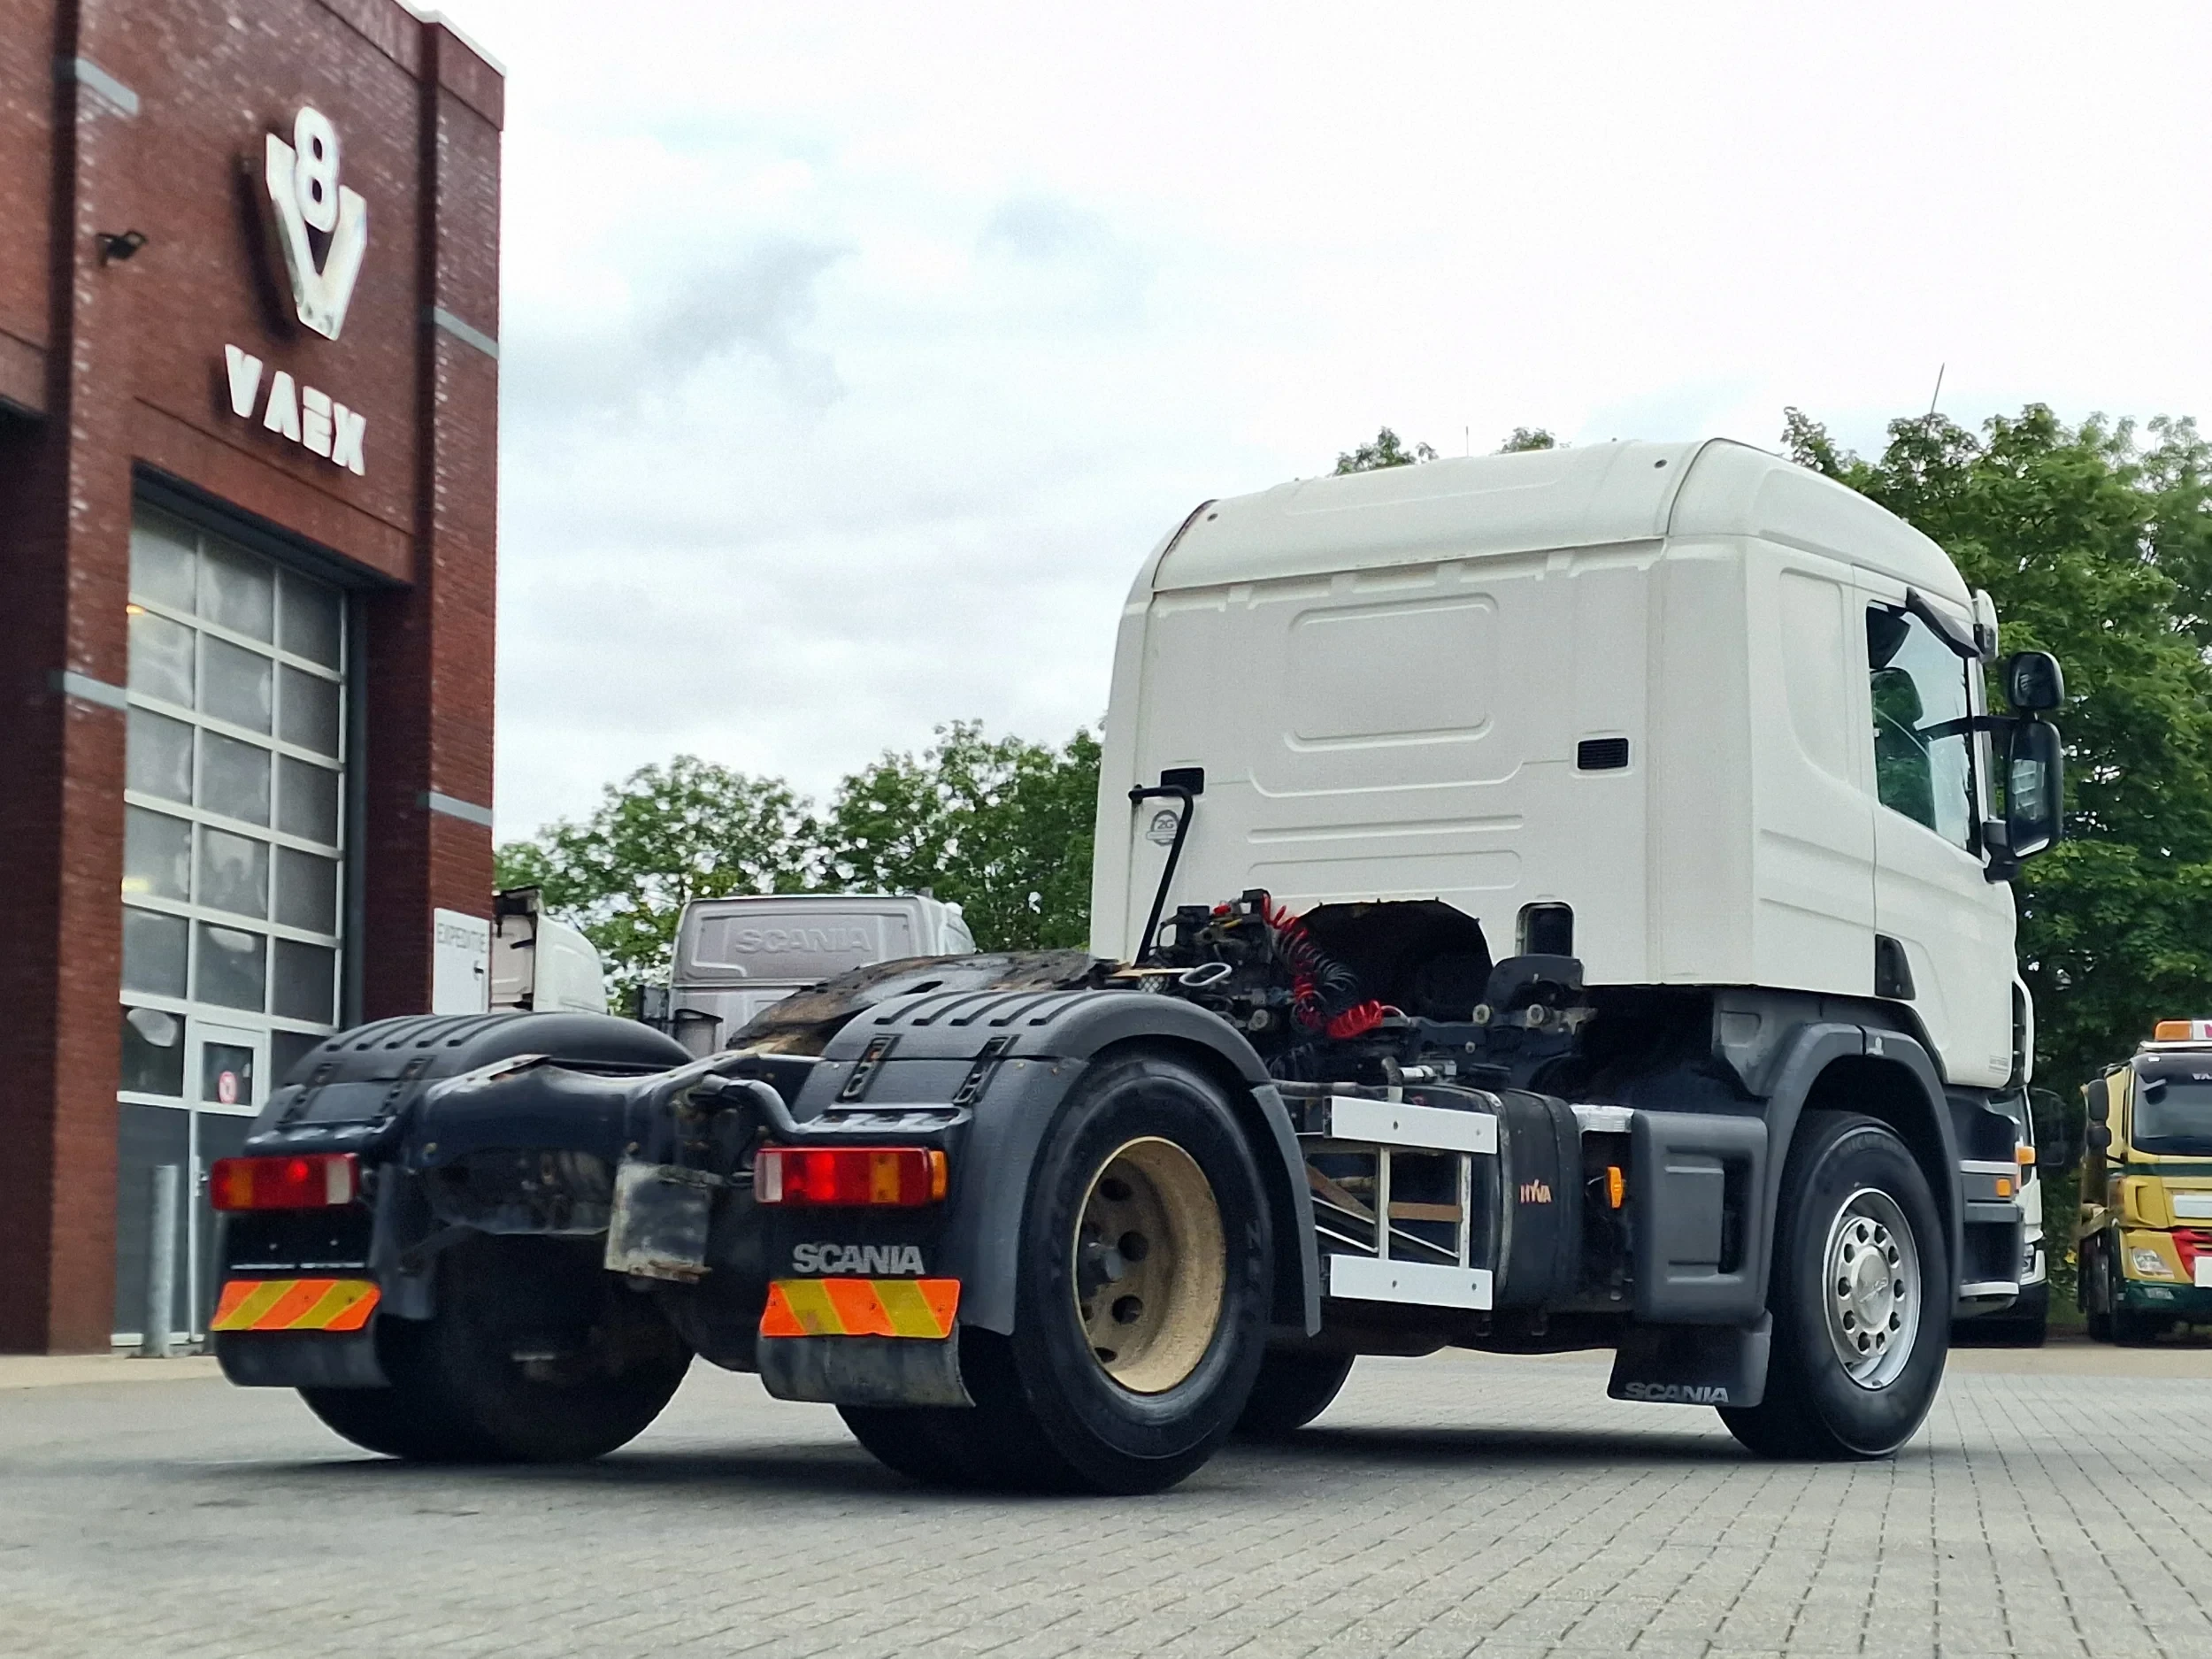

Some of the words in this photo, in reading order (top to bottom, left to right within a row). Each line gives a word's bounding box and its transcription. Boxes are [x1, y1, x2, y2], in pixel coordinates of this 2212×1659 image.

[225, 343, 366, 476] VAEX
[735, 929, 872, 953] SCANIA
[793, 1243, 926, 1275] SCANIA
[1624, 1382, 1729, 1403] SCANIA
